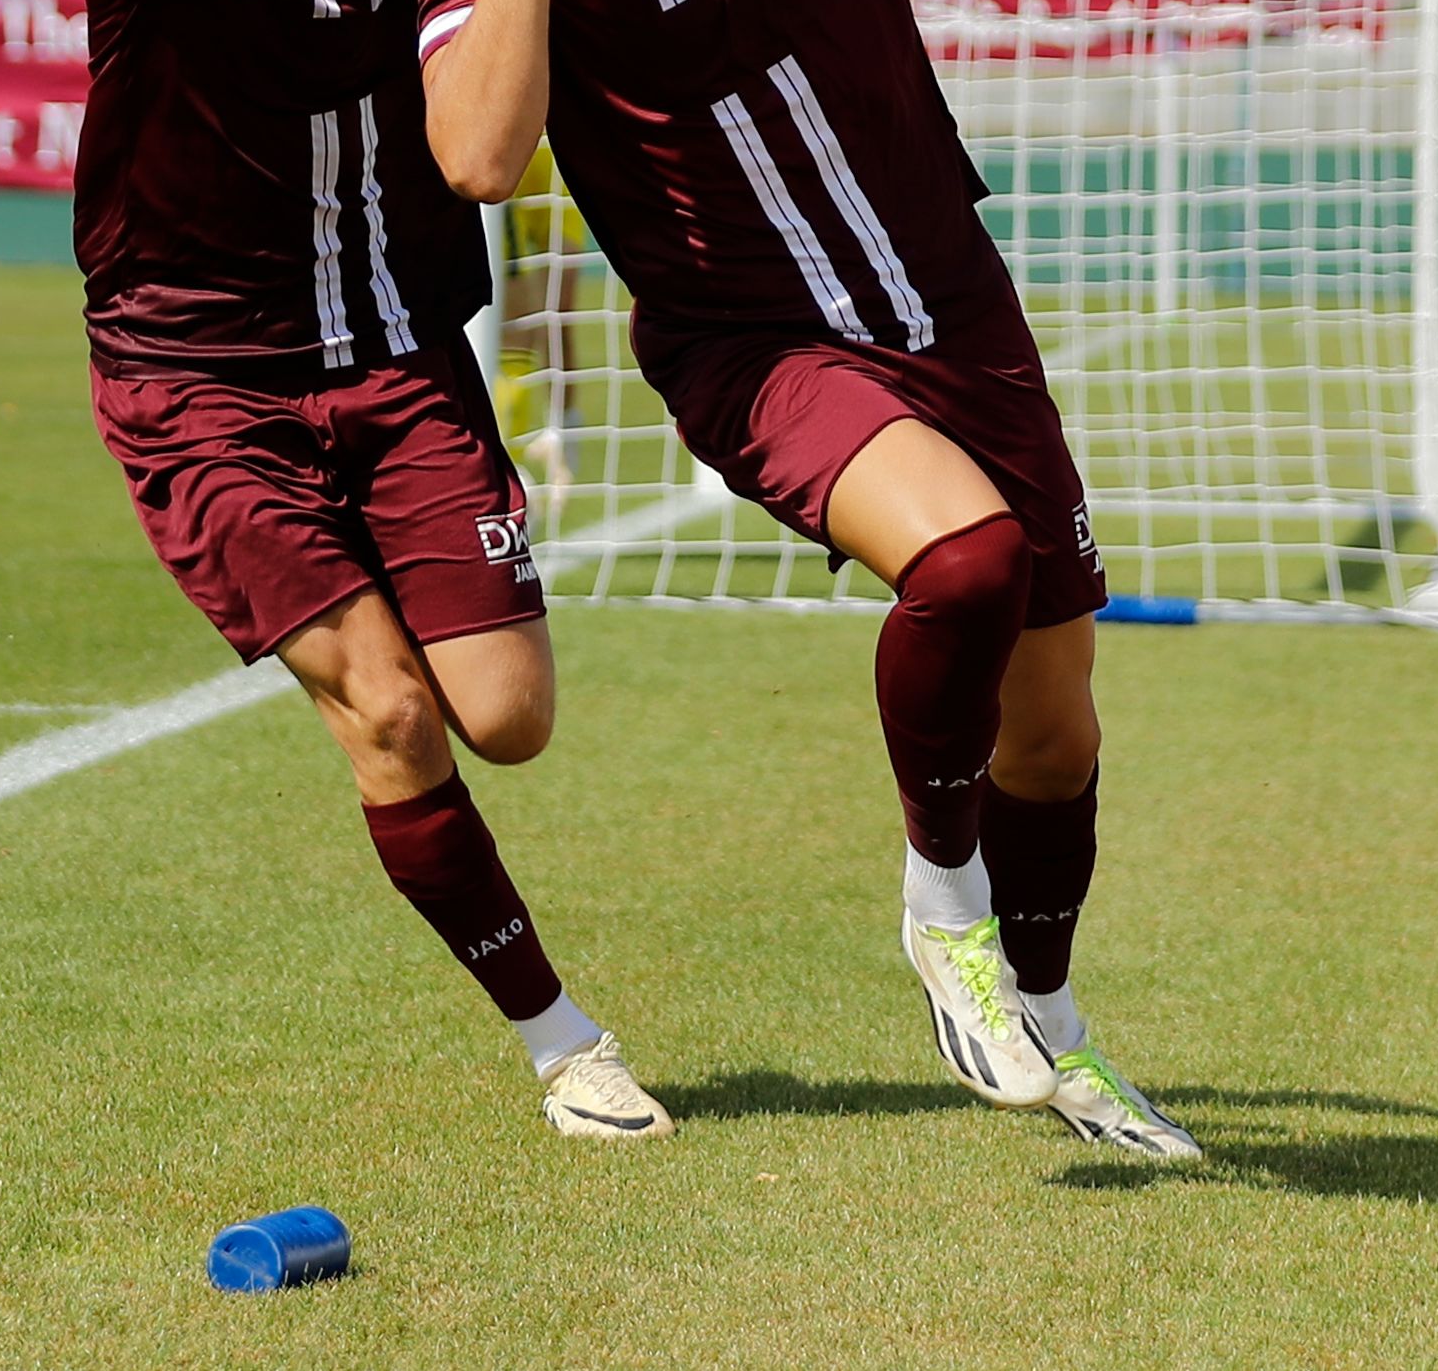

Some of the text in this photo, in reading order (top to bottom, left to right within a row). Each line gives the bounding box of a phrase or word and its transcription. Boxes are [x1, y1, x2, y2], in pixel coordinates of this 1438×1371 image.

[927, 745, 998, 788] JAK
[1010, 903, 1083, 922] JAK
[467, 917, 524, 961] JAKO
